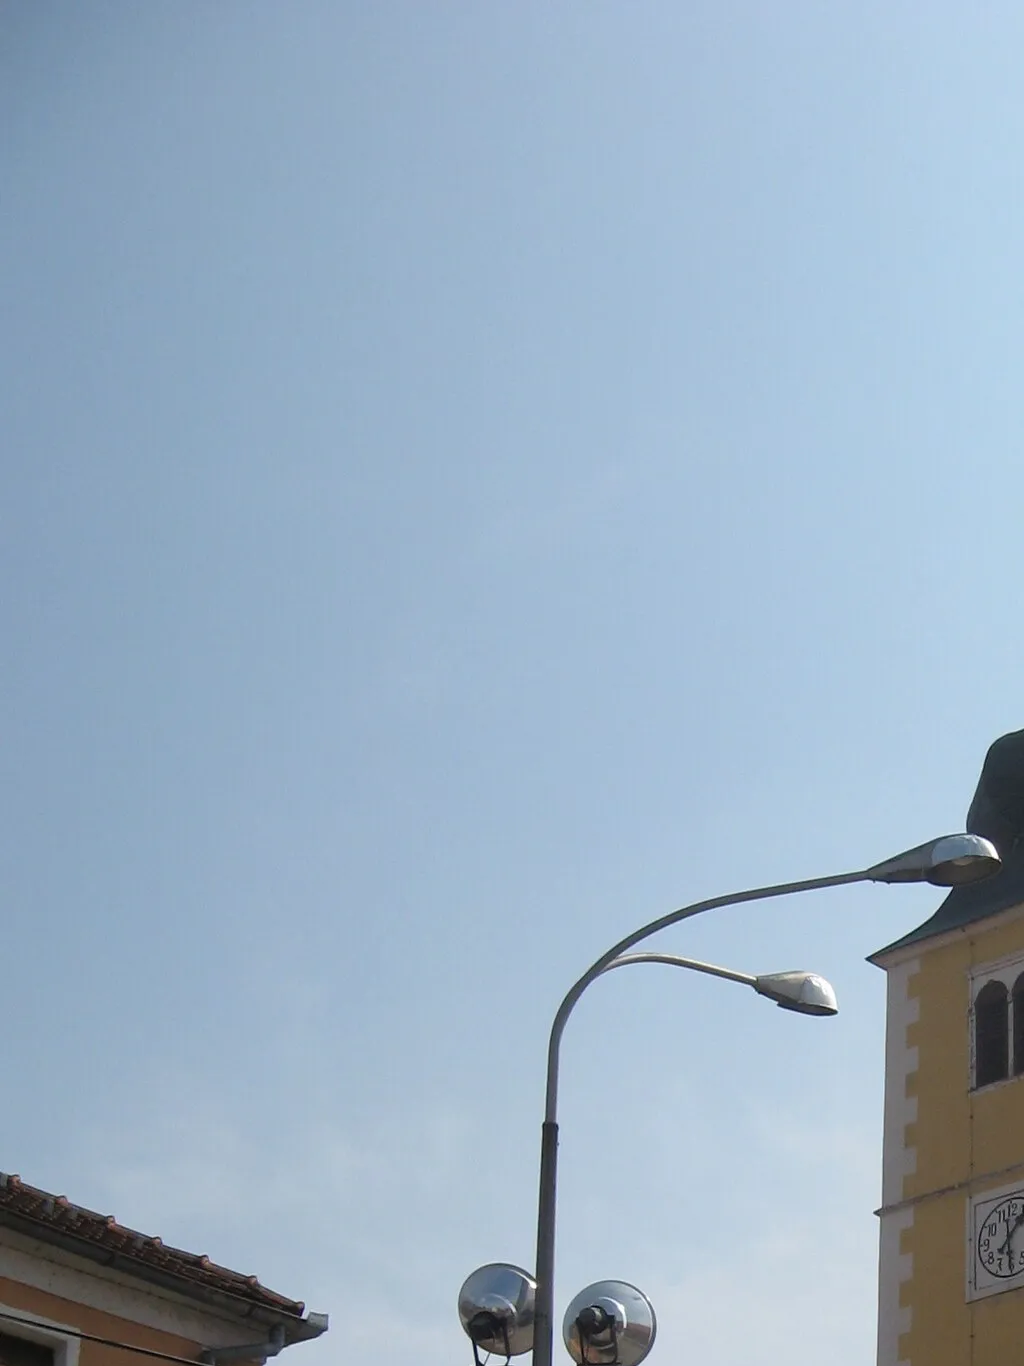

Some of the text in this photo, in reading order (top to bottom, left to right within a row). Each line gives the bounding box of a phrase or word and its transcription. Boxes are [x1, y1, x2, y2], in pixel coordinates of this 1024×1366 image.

[998, 1209, 1006, 1223] 11
[1008, 1203, 1018, 1217] 12
[987, 1223, 997, 1237] 10
[983, 1238, 990, 1252] 9
[988, 1251, 995, 1265] 8
[997, 1258, 1003, 1272] 7
